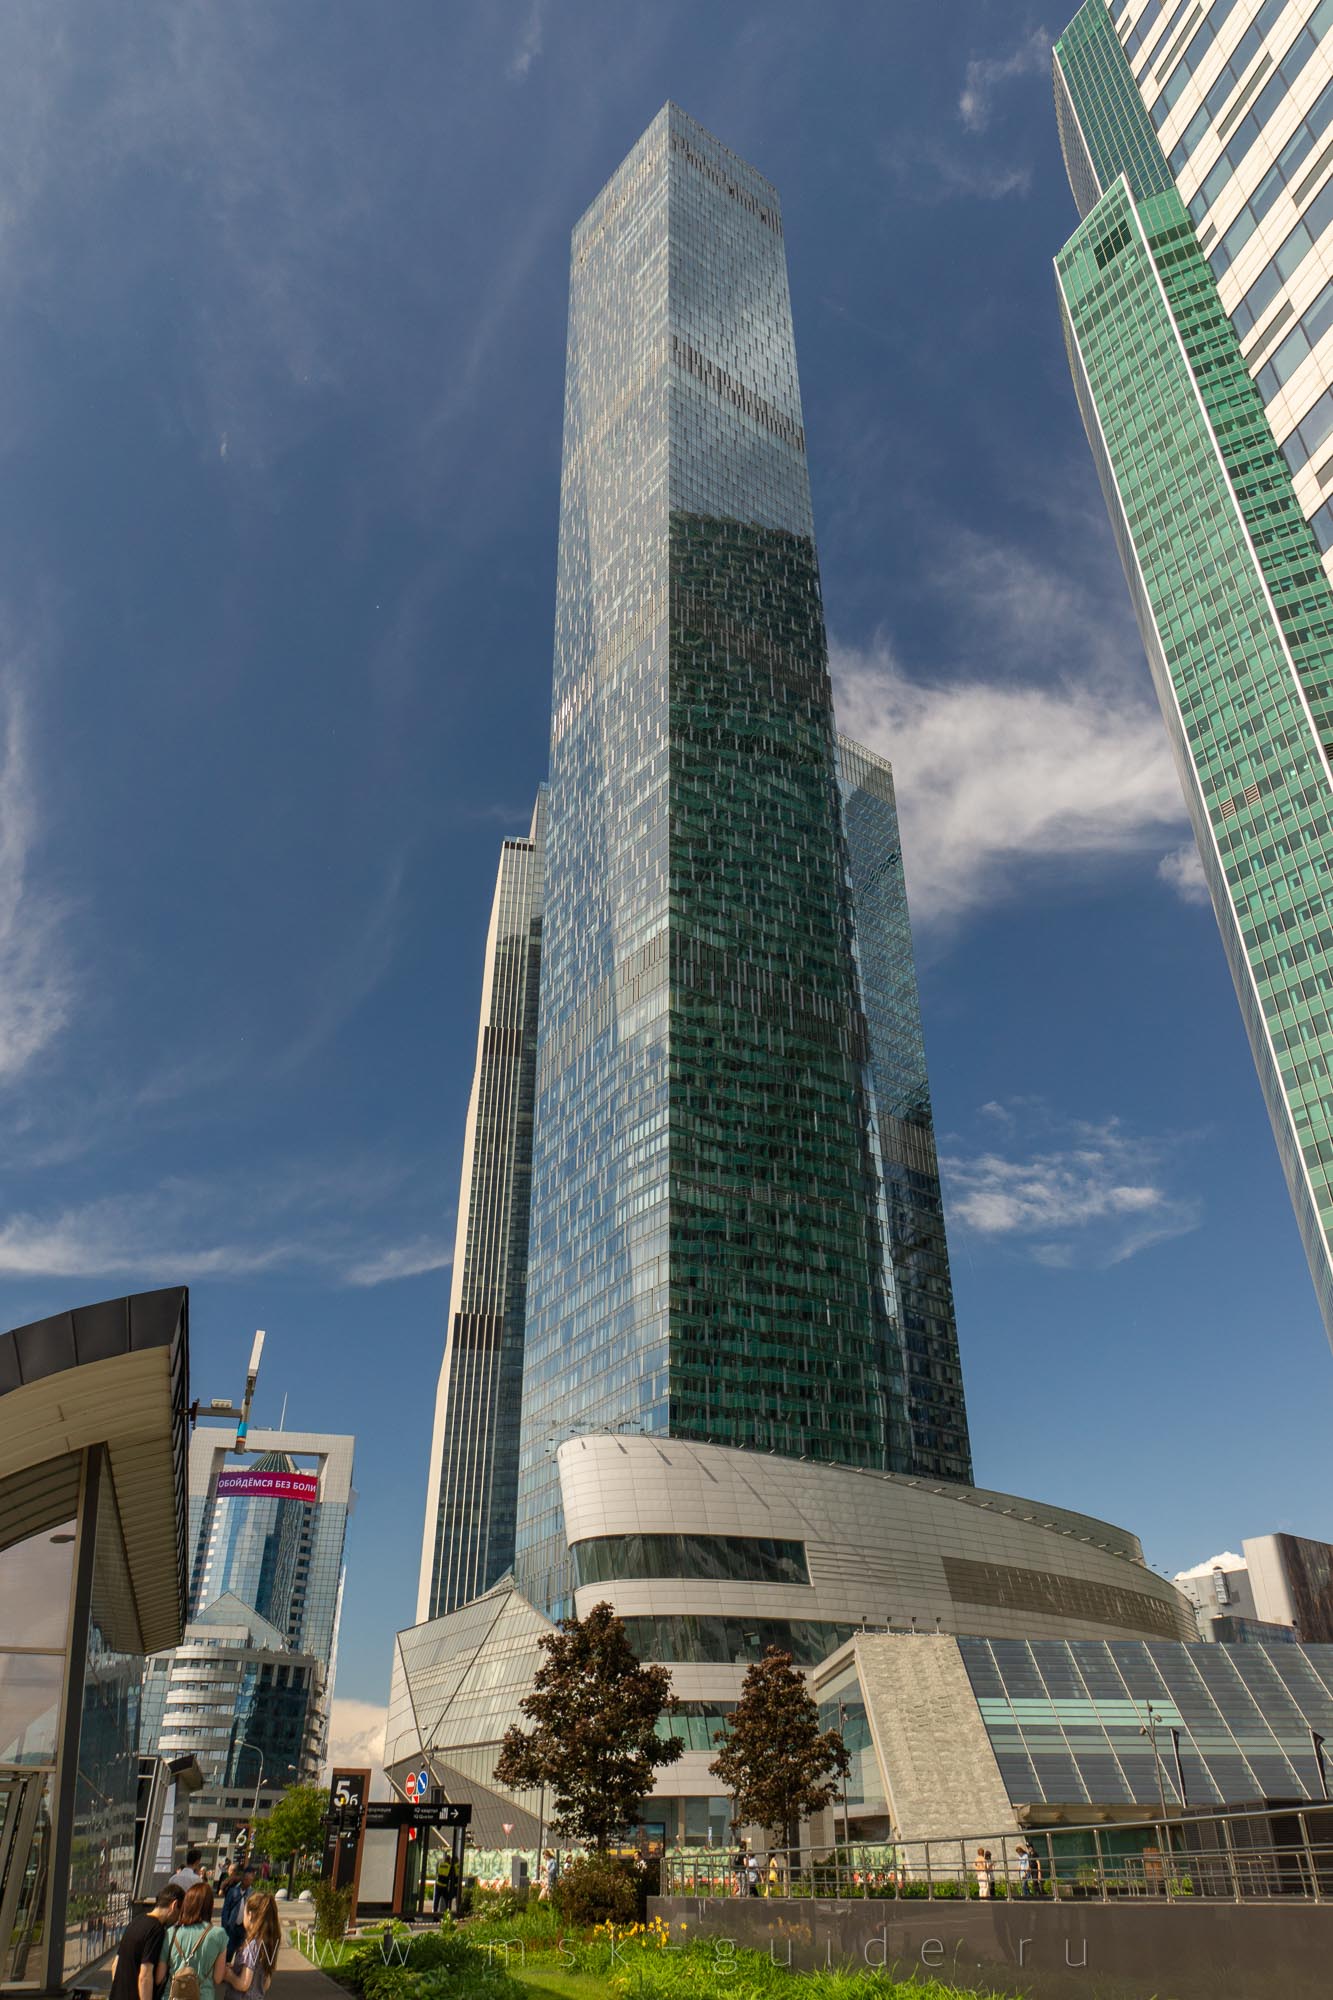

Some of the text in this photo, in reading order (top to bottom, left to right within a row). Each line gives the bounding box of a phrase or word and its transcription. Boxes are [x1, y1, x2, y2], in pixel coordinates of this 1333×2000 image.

[218, 1477, 317, 1492] ОБОЙДЁМСЯ БЕЗ БОЛИ
[235, 1828, 247, 1847] 6
